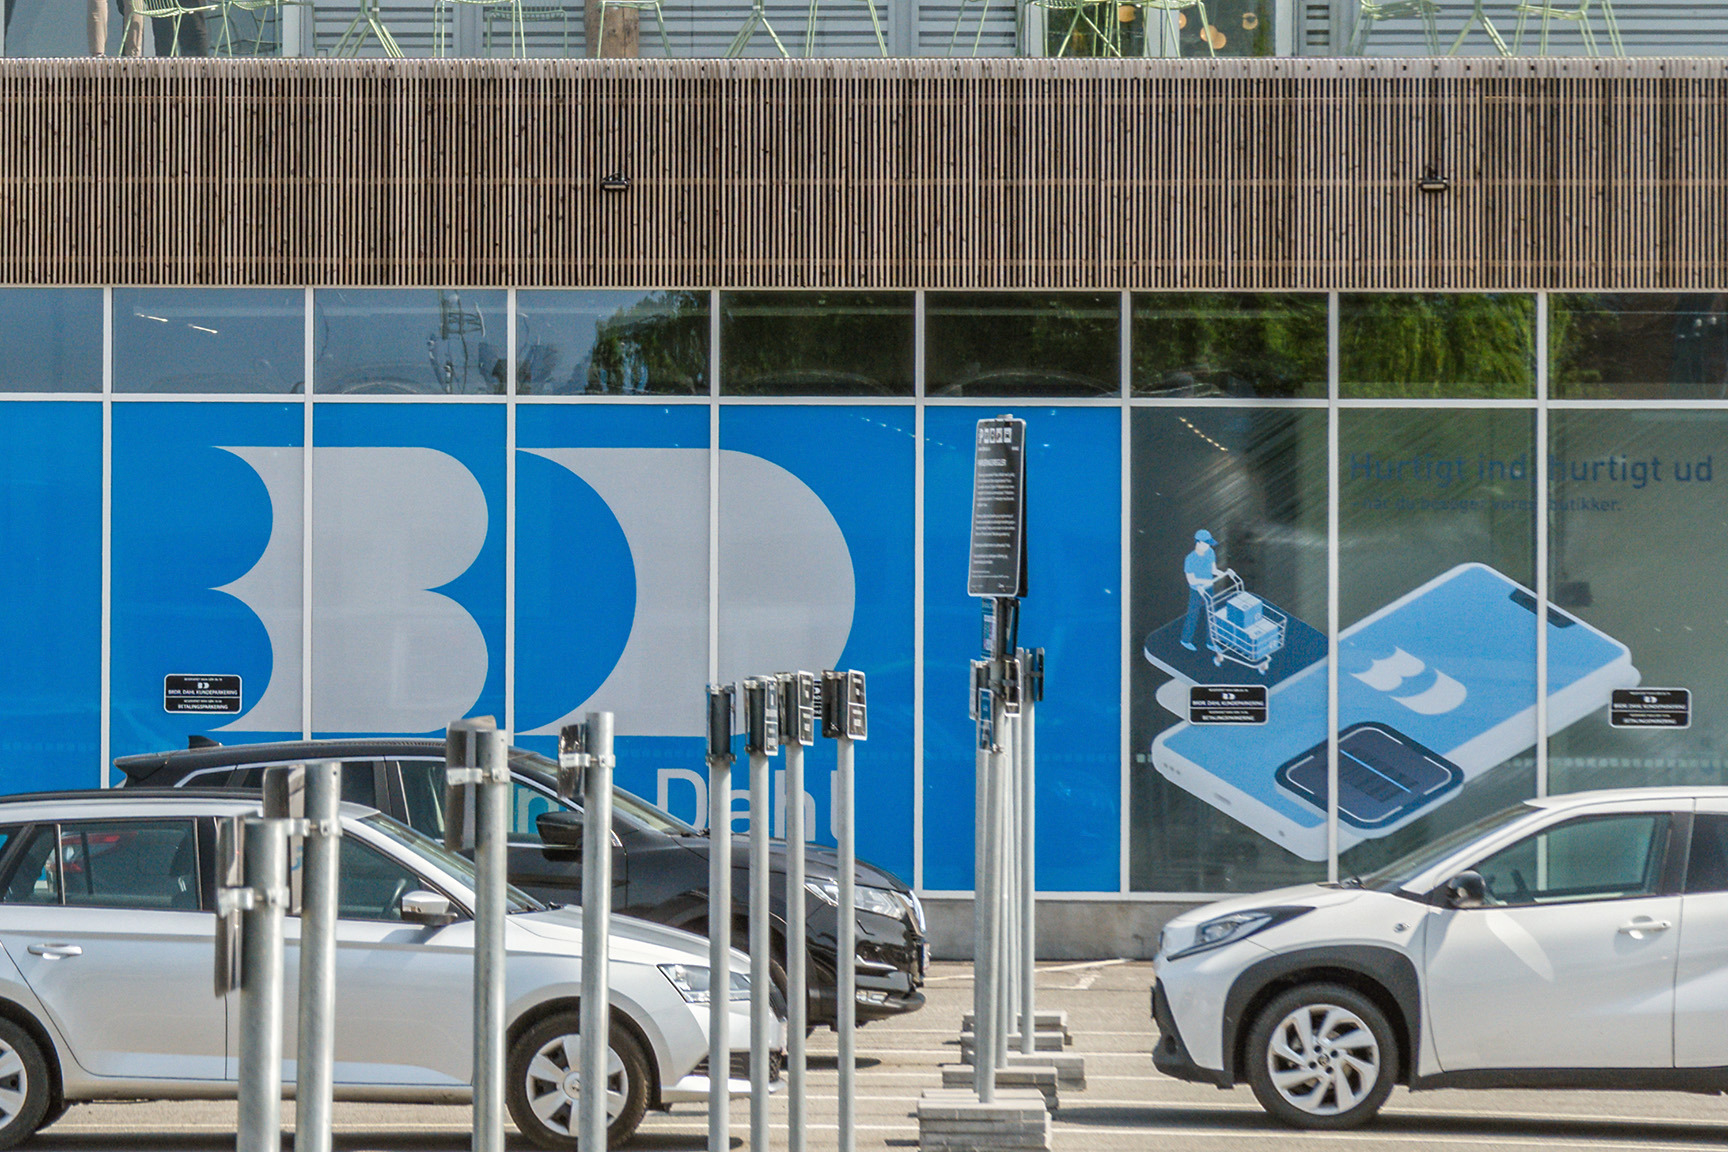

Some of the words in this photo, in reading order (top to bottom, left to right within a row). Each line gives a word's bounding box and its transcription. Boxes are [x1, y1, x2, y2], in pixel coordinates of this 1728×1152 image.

[1349, 451, 1466, 489] Hurtigt
[1549, 453, 1662, 490] hurtigt
[1673, 455, 1713, 482] ud
[207, 445, 855, 736] BD
